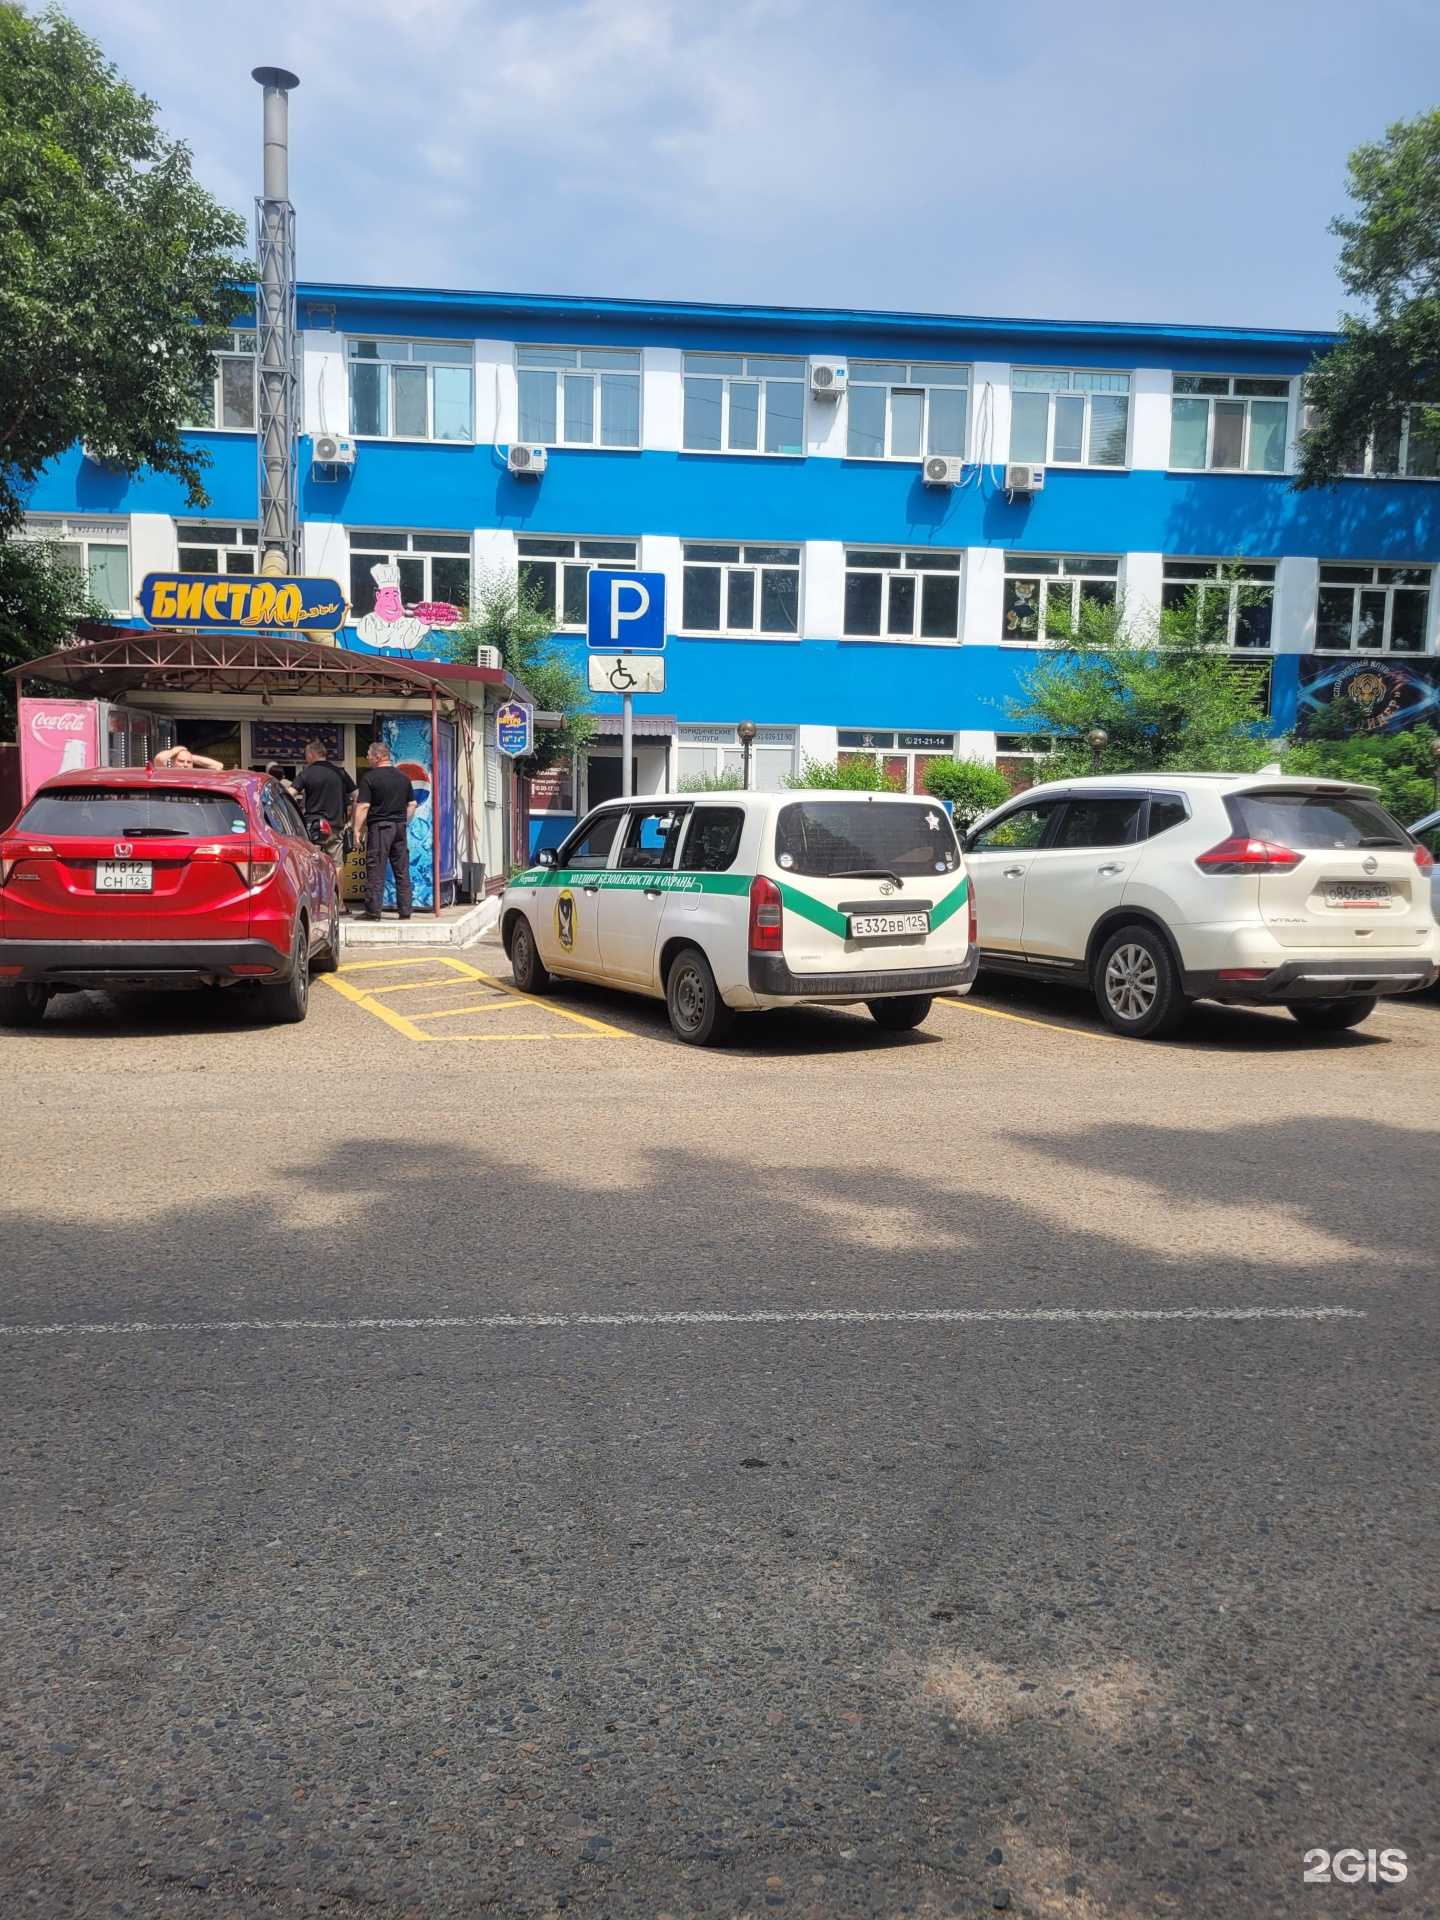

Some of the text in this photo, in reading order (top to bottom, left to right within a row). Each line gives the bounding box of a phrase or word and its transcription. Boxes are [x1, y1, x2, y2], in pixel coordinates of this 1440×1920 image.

[151, 581, 302, 620] БИСТРО
[611, 579, 650, 640] P
[679, 727, 731, 736] ЮРИДИЧЕСКИЕ
[693, 735, 719, 743] УСЛУГИ
[119, 861, 144, 874] 812
